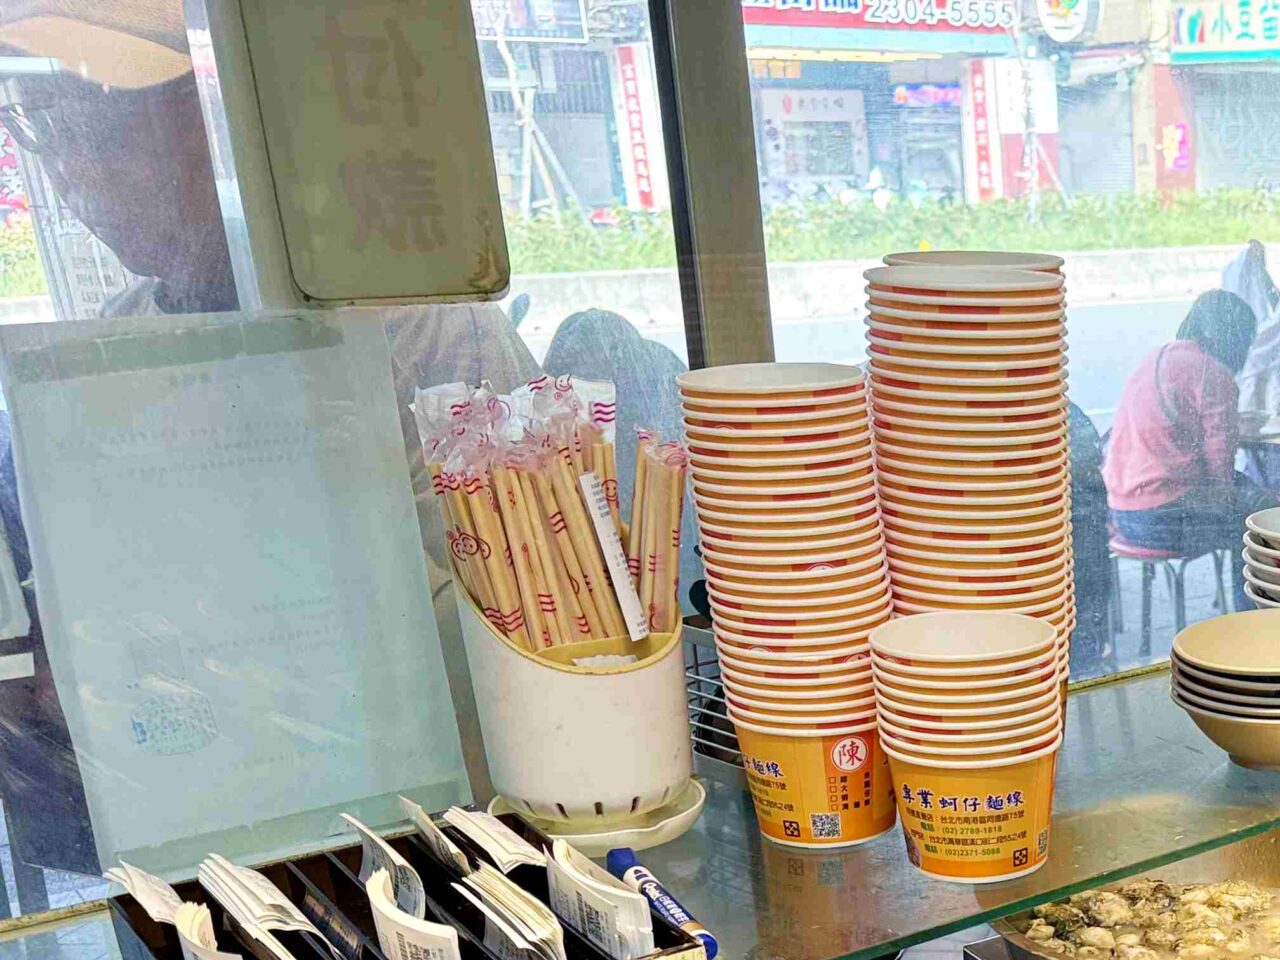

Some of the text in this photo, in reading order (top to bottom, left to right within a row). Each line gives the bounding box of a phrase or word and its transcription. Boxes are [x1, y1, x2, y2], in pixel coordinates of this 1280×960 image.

[870, 0, 1012, 25] 2304-5555
[838, 741, 863, 767] 陳
[902, 784, 1025, 811] 專業蚵仔麵線
